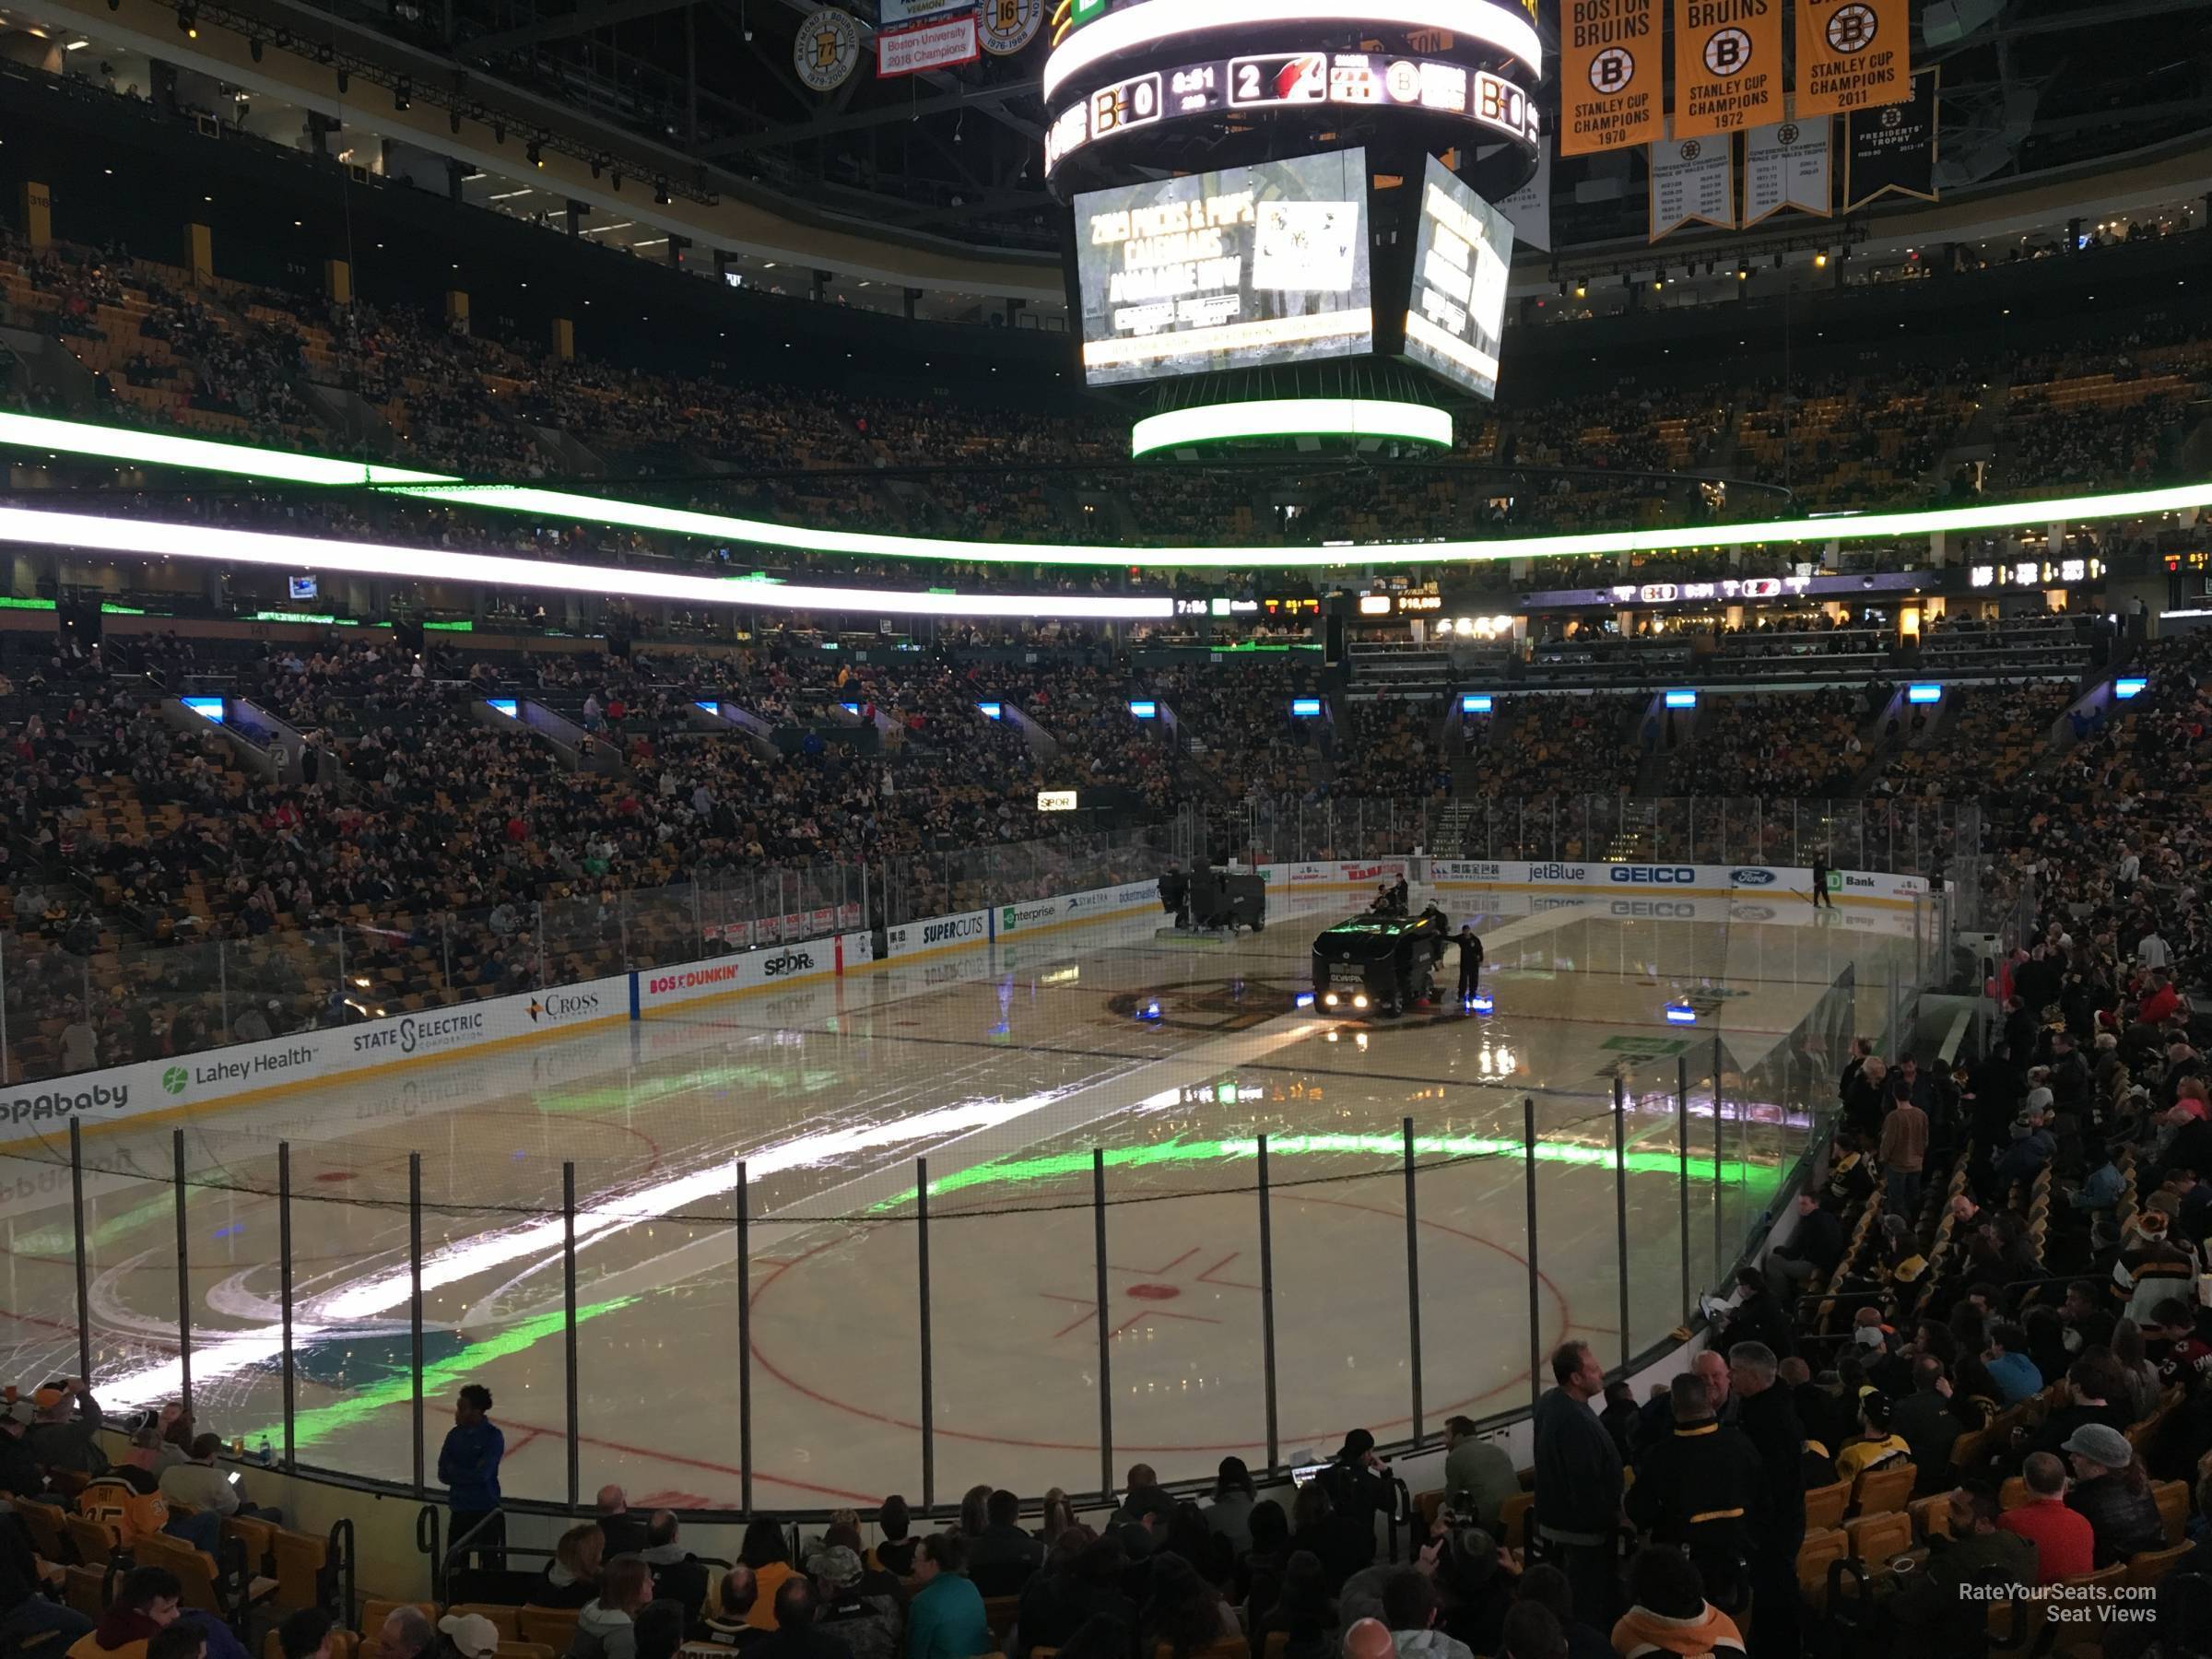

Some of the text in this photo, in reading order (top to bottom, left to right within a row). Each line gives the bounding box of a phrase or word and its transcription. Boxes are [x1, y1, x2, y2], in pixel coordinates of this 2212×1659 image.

[1000, 1, 1015, 21] 16
[1688, 0, 1768, 29] BRUINS
[798, 15, 819, 61] RAYMOND
[831, 12, 855, 50] BOURQUE
[888, 27, 966, 53] Boston University
[987, 31, 1028, 49] 1976-1988
[1574, 13, 1650, 47] BRUINS
[818, 41, 834, 57] 77
[888, 43, 967, 67] 2018 Champions
[806, 65, 847, 84] 1979-2000
[1811, 51, 1894, 78] STANLEY CUP
[1239, 64, 1261, 99] 2
[1689, 74, 1768, 100] STANLEY CUP
[1810, 68, 1895, 95] CHAMPIONS
[1135, 83, 1153, 115] 0
[1574, 93, 1649, 118] STANLEY CUP
[1688, 90, 1769, 116] CHAMPIONS
[1838, 89, 1867, 107] 2011
[1574, 109, 1650, 134] CHAMPIONS
[1715, 111, 1744, 128] 1972
[1599, 129, 1626, 145] 1970
[1860, 125, 1924, 140] PRESIDENTS'
[1872, 135, 1910, 147] TROPHY
[1528, 864, 1584, 882] jetBlue
[1610, 867, 1695, 883] GEICO
[1738, 869, 1767, 884] Ford
[1846, 876, 1875, 887] Bank
[1119, 888, 1157, 904] ticketmaster
[1006, 904, 1055, 924] enterprise
[924, 916, 982, 944] SUPERCUTS
[650, 964, 739, 994] BOS DUNKIN'
[545, 993, 599, 1017] CROSS
[354, 1029, 397, 1052] STATE
[418, 1013, 483, 1039] ELECTRIC
[196, 1047, 312, 1085] Lahey Health
